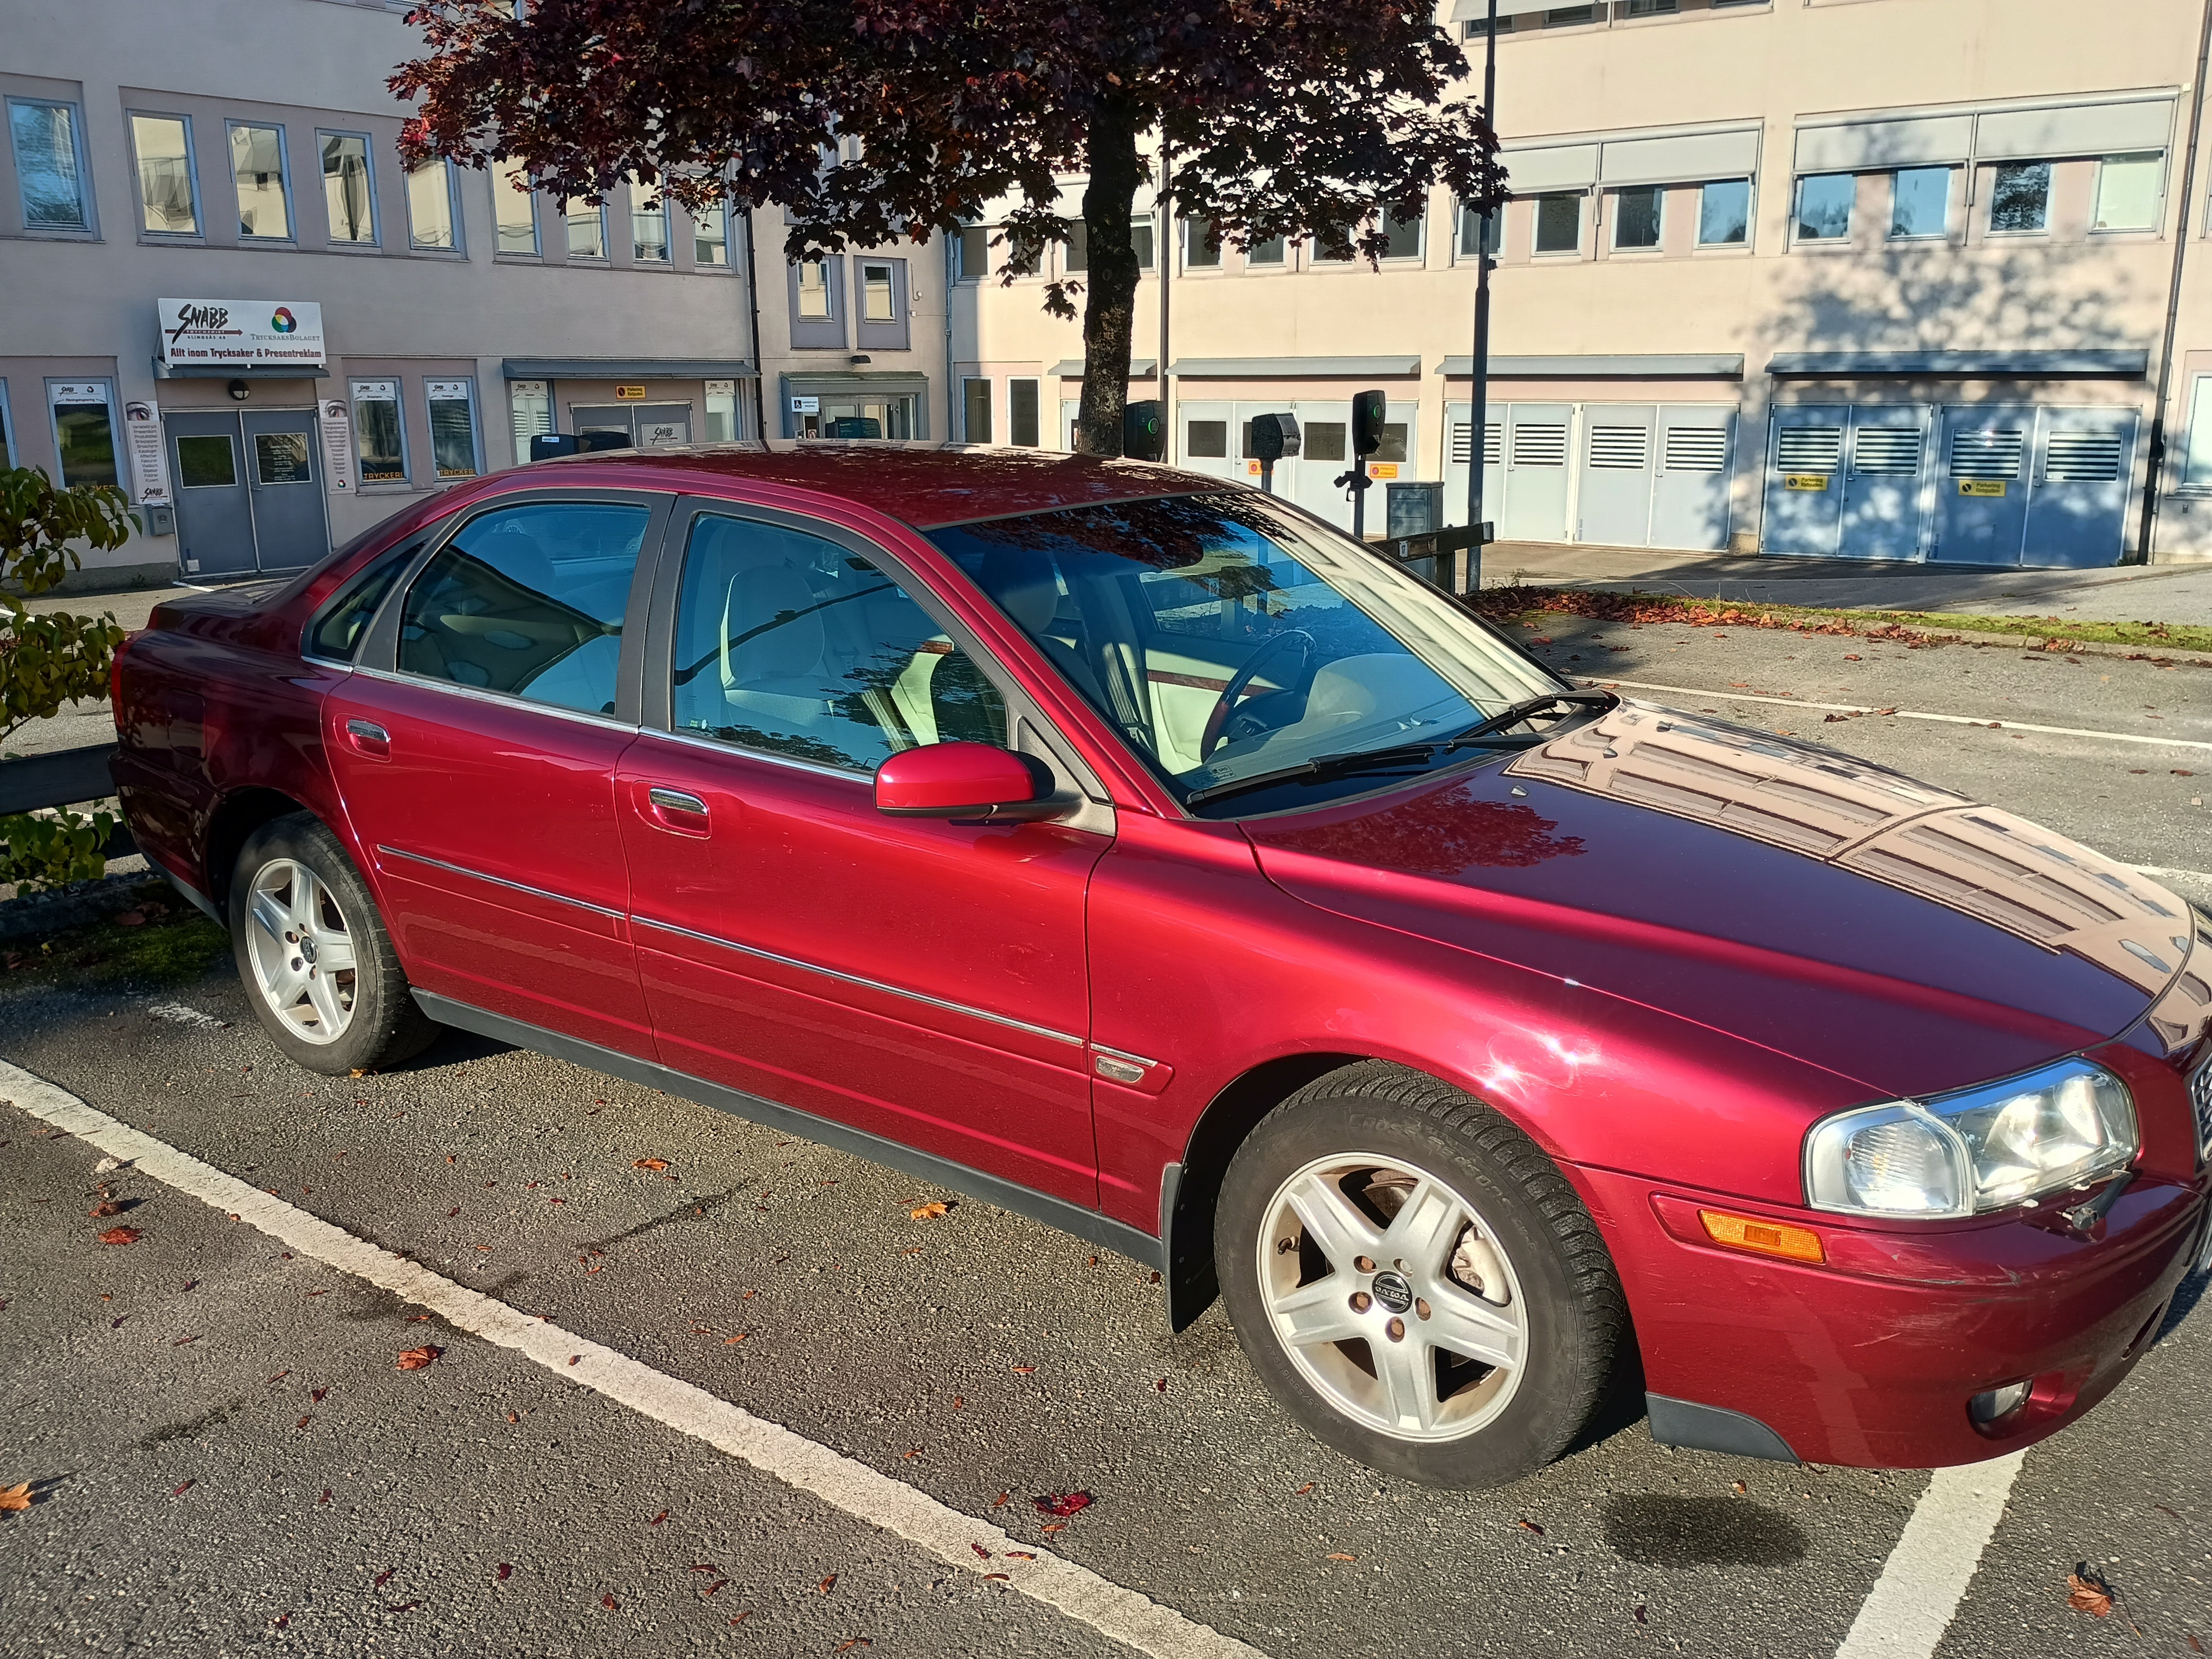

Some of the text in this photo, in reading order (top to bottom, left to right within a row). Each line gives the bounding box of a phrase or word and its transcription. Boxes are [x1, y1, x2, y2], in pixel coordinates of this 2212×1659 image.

[172, 303, 228, 345] SNABB
[171, 348, 322, 359] Allt inom Trycksaker & Presentreklam
[363, 471, 403, 480] TRYCKERI
[1401, 545, 1406, 554] 17
[1375, 1286, 1409, 1301] VOLVO
